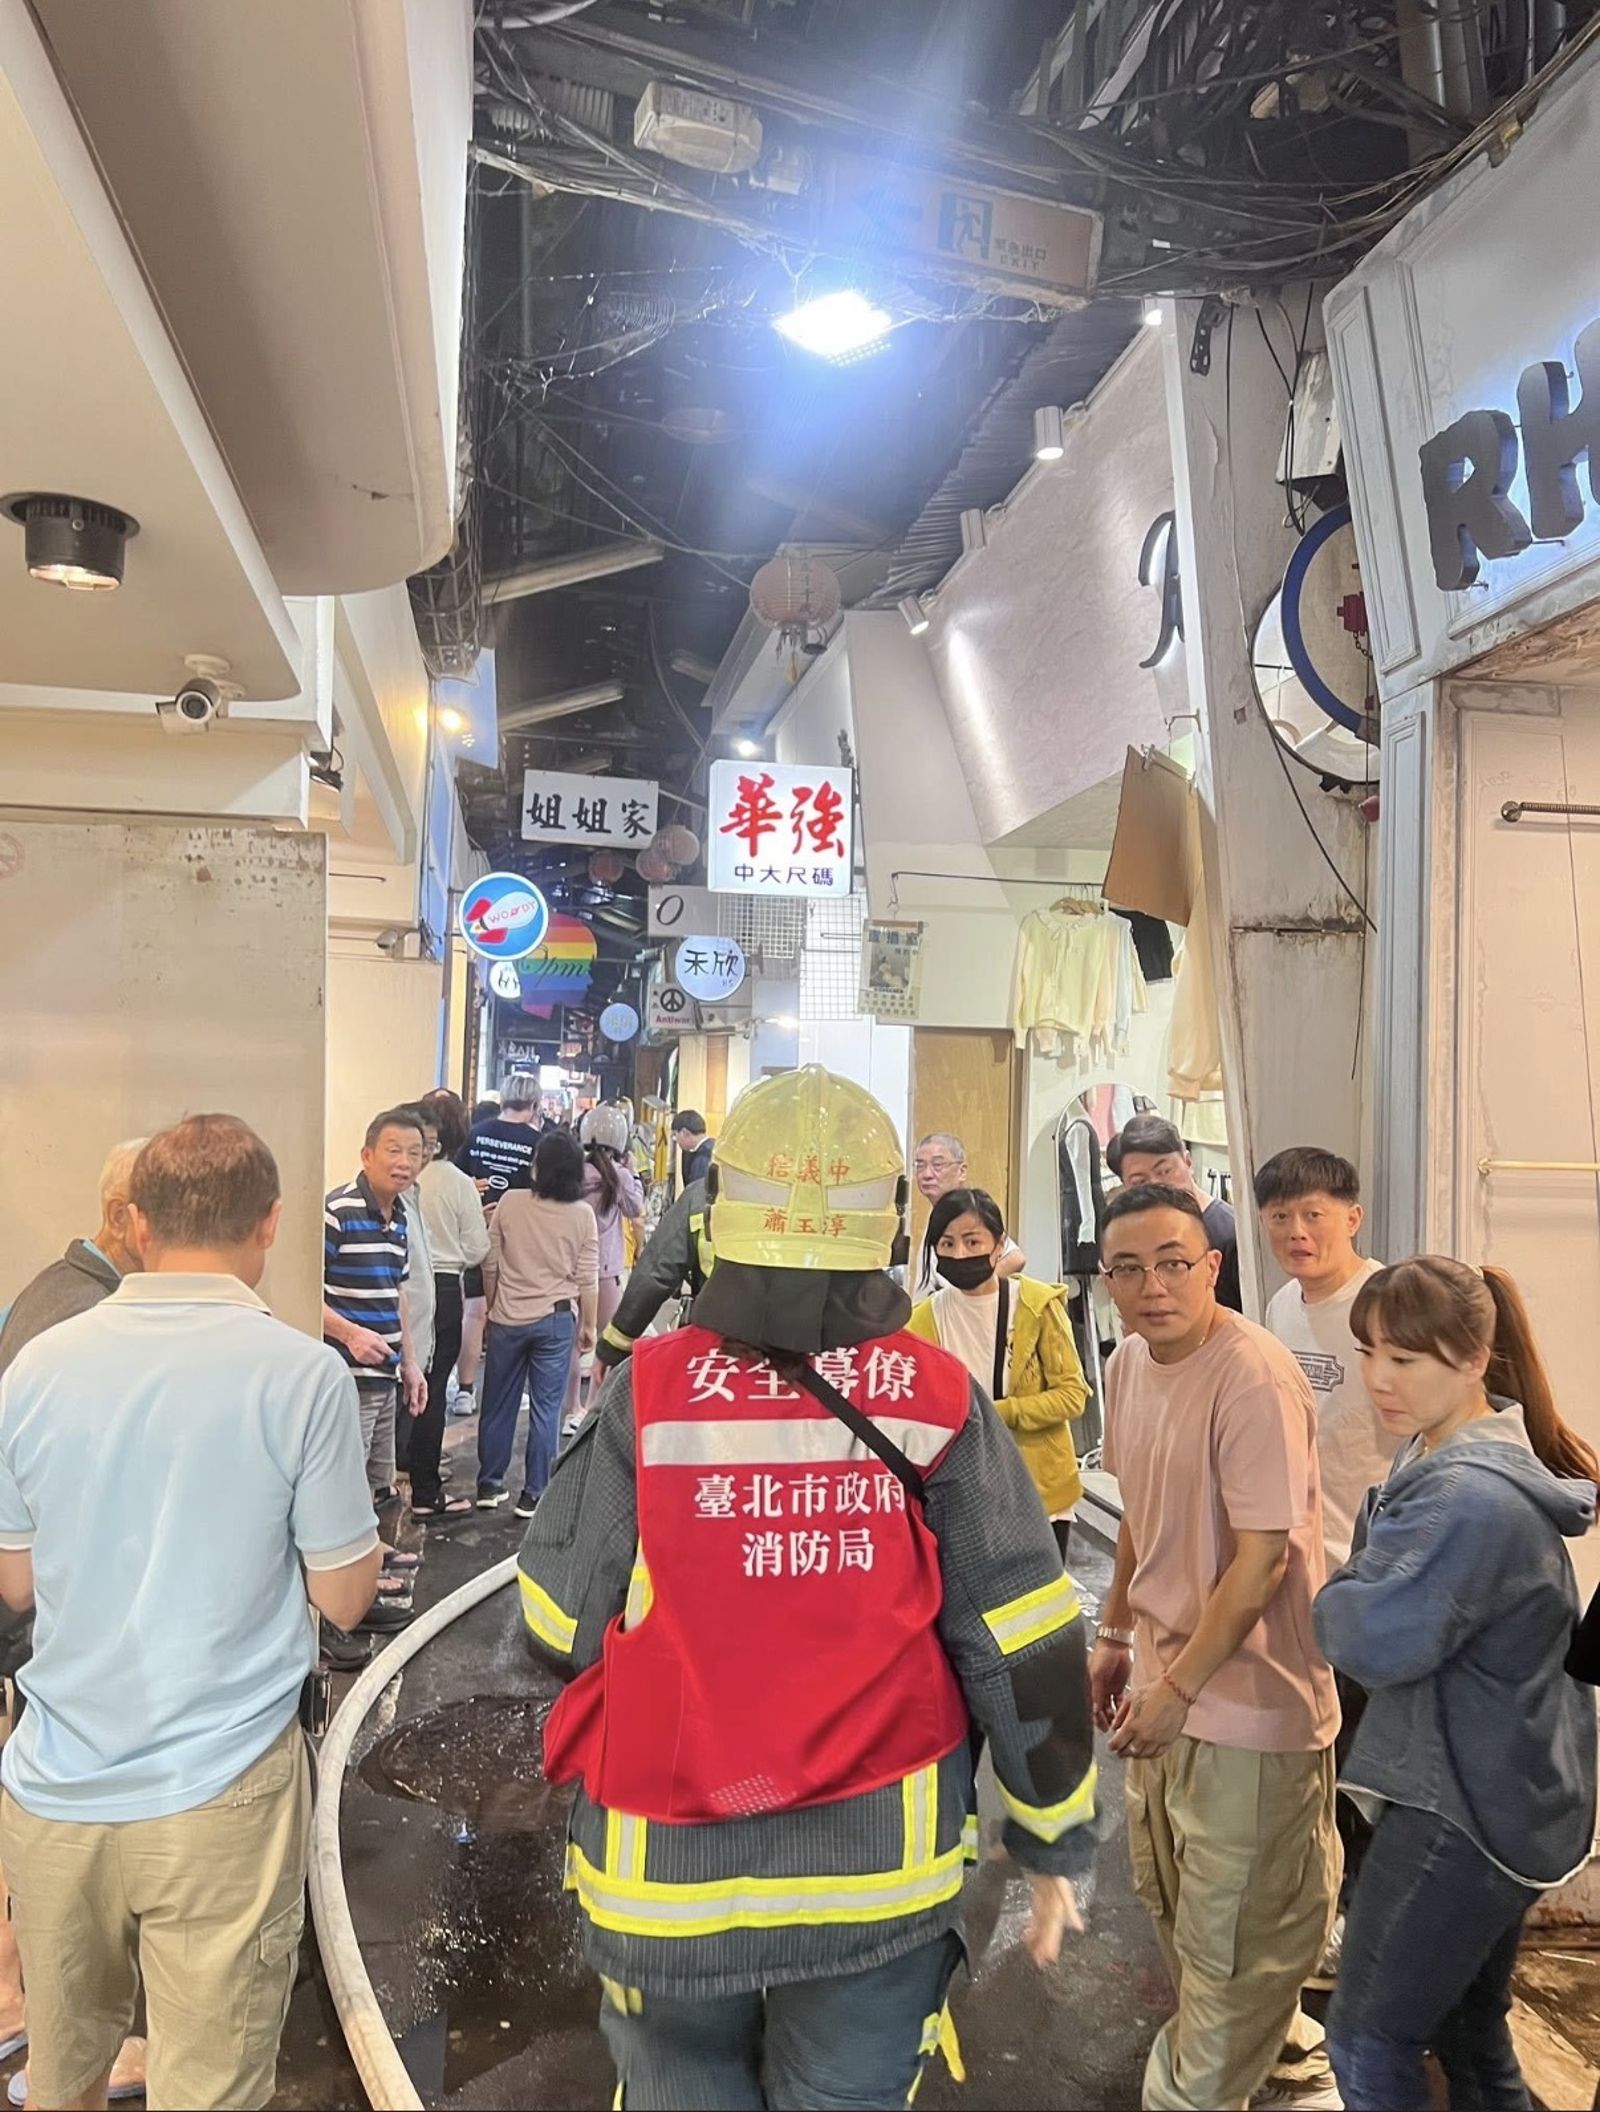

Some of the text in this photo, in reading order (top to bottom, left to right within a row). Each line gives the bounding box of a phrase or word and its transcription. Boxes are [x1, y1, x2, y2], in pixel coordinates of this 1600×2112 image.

[526, 793, 652, 839] 姐姐家
[719, 772, 845, 858] 華強
[734, 863, 834, 886] 中大尺碼
[684, 948, 739, 977] 禾欣
[475, 1136, 533, 1155] PERSEVERANCE
[694, 1472, 905, 1518] 臺北市政府
[741, 1527, 875, 1578] 消防局
